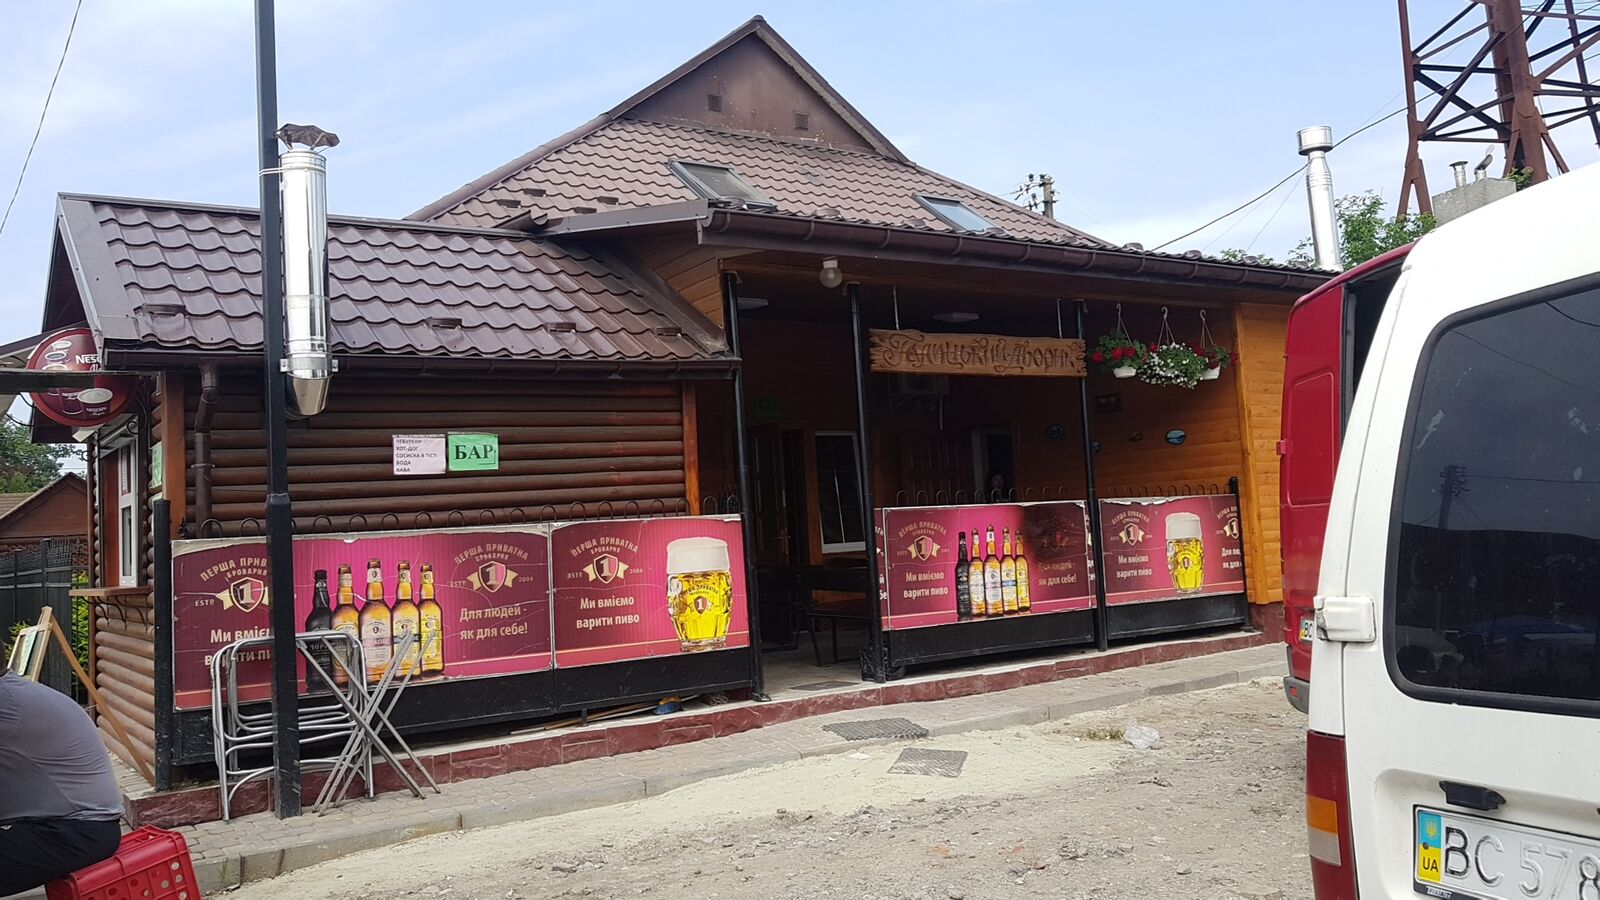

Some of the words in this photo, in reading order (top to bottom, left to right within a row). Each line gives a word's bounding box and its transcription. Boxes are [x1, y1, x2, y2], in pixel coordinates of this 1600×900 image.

[454, 444, 494, 460] БАР
[454, 545, 483, 565] ПЕРША
[486, 543, 529, 560] ПРИВАТНА
[571, 538, 598, 557] ПЕРША
[600, 537, 639, 553] ПРИВАТНА
[200, 559, 237, 582] ПЕРША
[226, 567, 268, 579] БРОВАРНЯ
[486, 564, 500, 586] 1
[600, 557, 612, 577] 1
[905, 572, 917, 582] Ми
[239, 581, 257, 605] 1
[580, 597, 596, 610] Ми
[598, 594, 635, 608] вміємо
[903, 588, 930, 600] варити
[930, 587, 949, 596] пиво
[460, 607, 482, 623] Для
[484, 604, 521, 619] людей
[576, 616, 613, 631] варити
[615, 614, 640, 625] пиво
[210, 629, 232, 643] Ми
[460, 630, 475, 641] як
[476, 627, 498, 641] для
[500, 621, 528, 636] себе!
[1422, 857, 1439, 873] UA
[1444, 826, 1504, 886] BC
